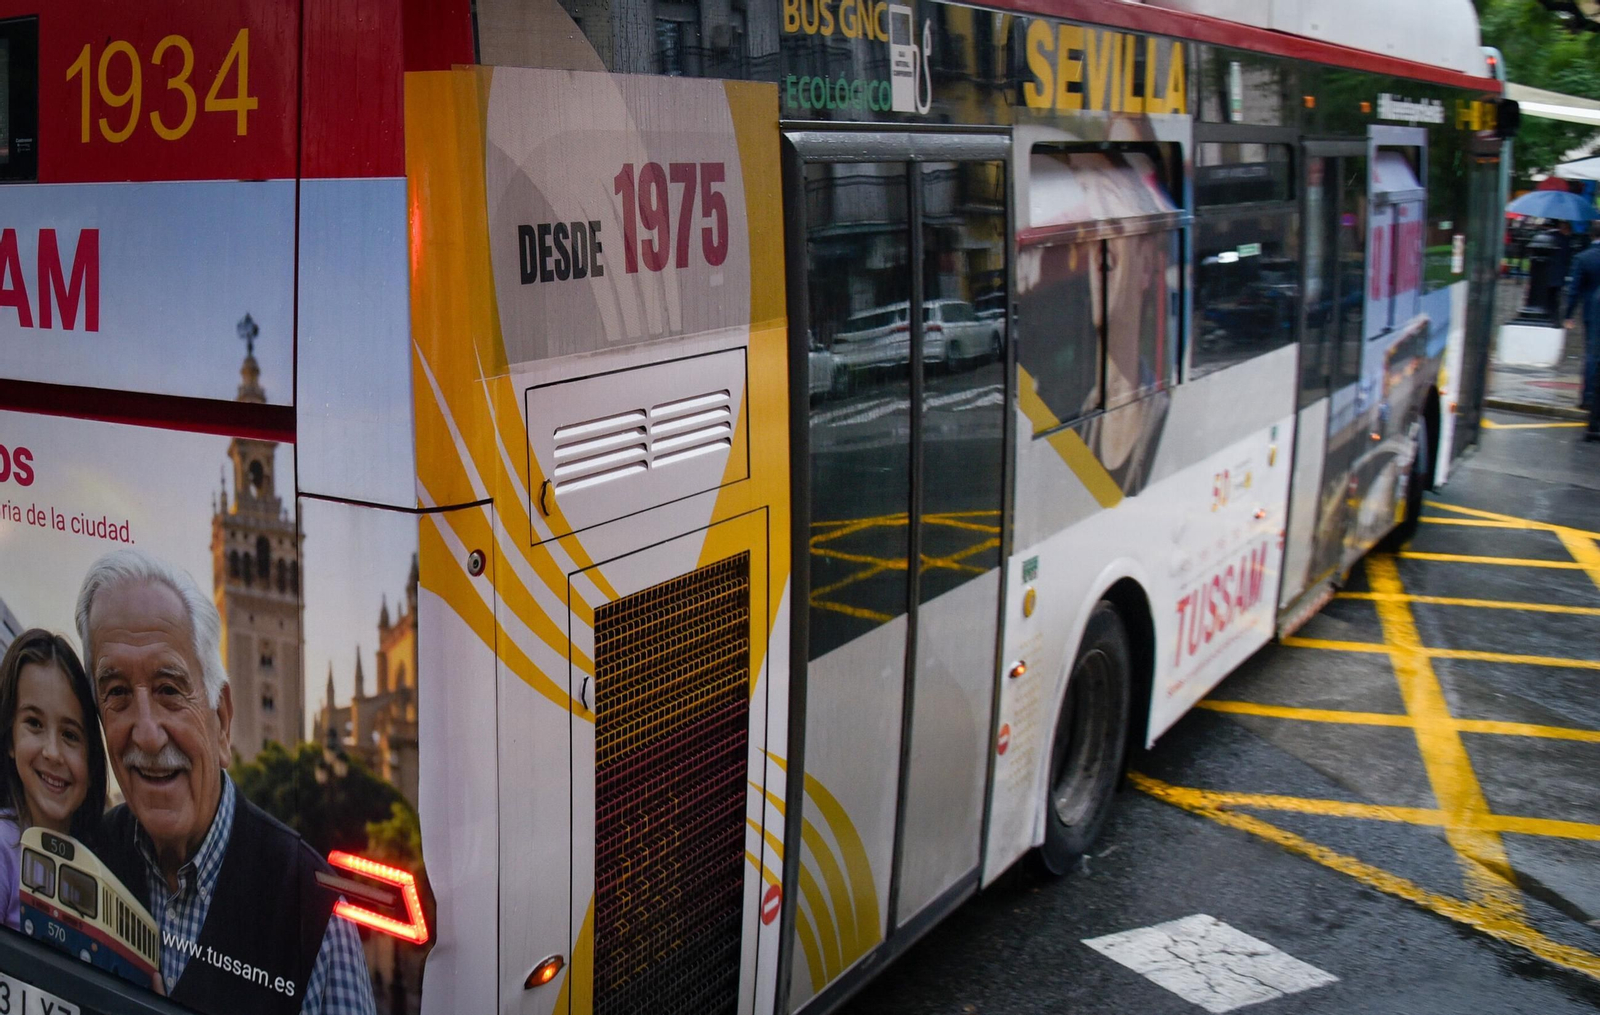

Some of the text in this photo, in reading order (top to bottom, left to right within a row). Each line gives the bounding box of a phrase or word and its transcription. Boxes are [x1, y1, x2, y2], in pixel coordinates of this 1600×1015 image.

[783, 0, 889, 42] BUS GNC
[66, 27, 259, 144] 1934
[785, 70, 892, 112] ECOLÓGICO
[1022, 18, 1187, 116] SEVILLA
[613, 161, 729, 274] 1975
[517, 219, 605, 286] DESDE
[0, 499, 136, 545] ria de la ciudad.
[1175, 540, 1268, 669] TUSSAM
[50, 838, 66, 857] 50
[48, 921, 66, 942] 570
[162, 929, 296, 998] www.tussam.es
